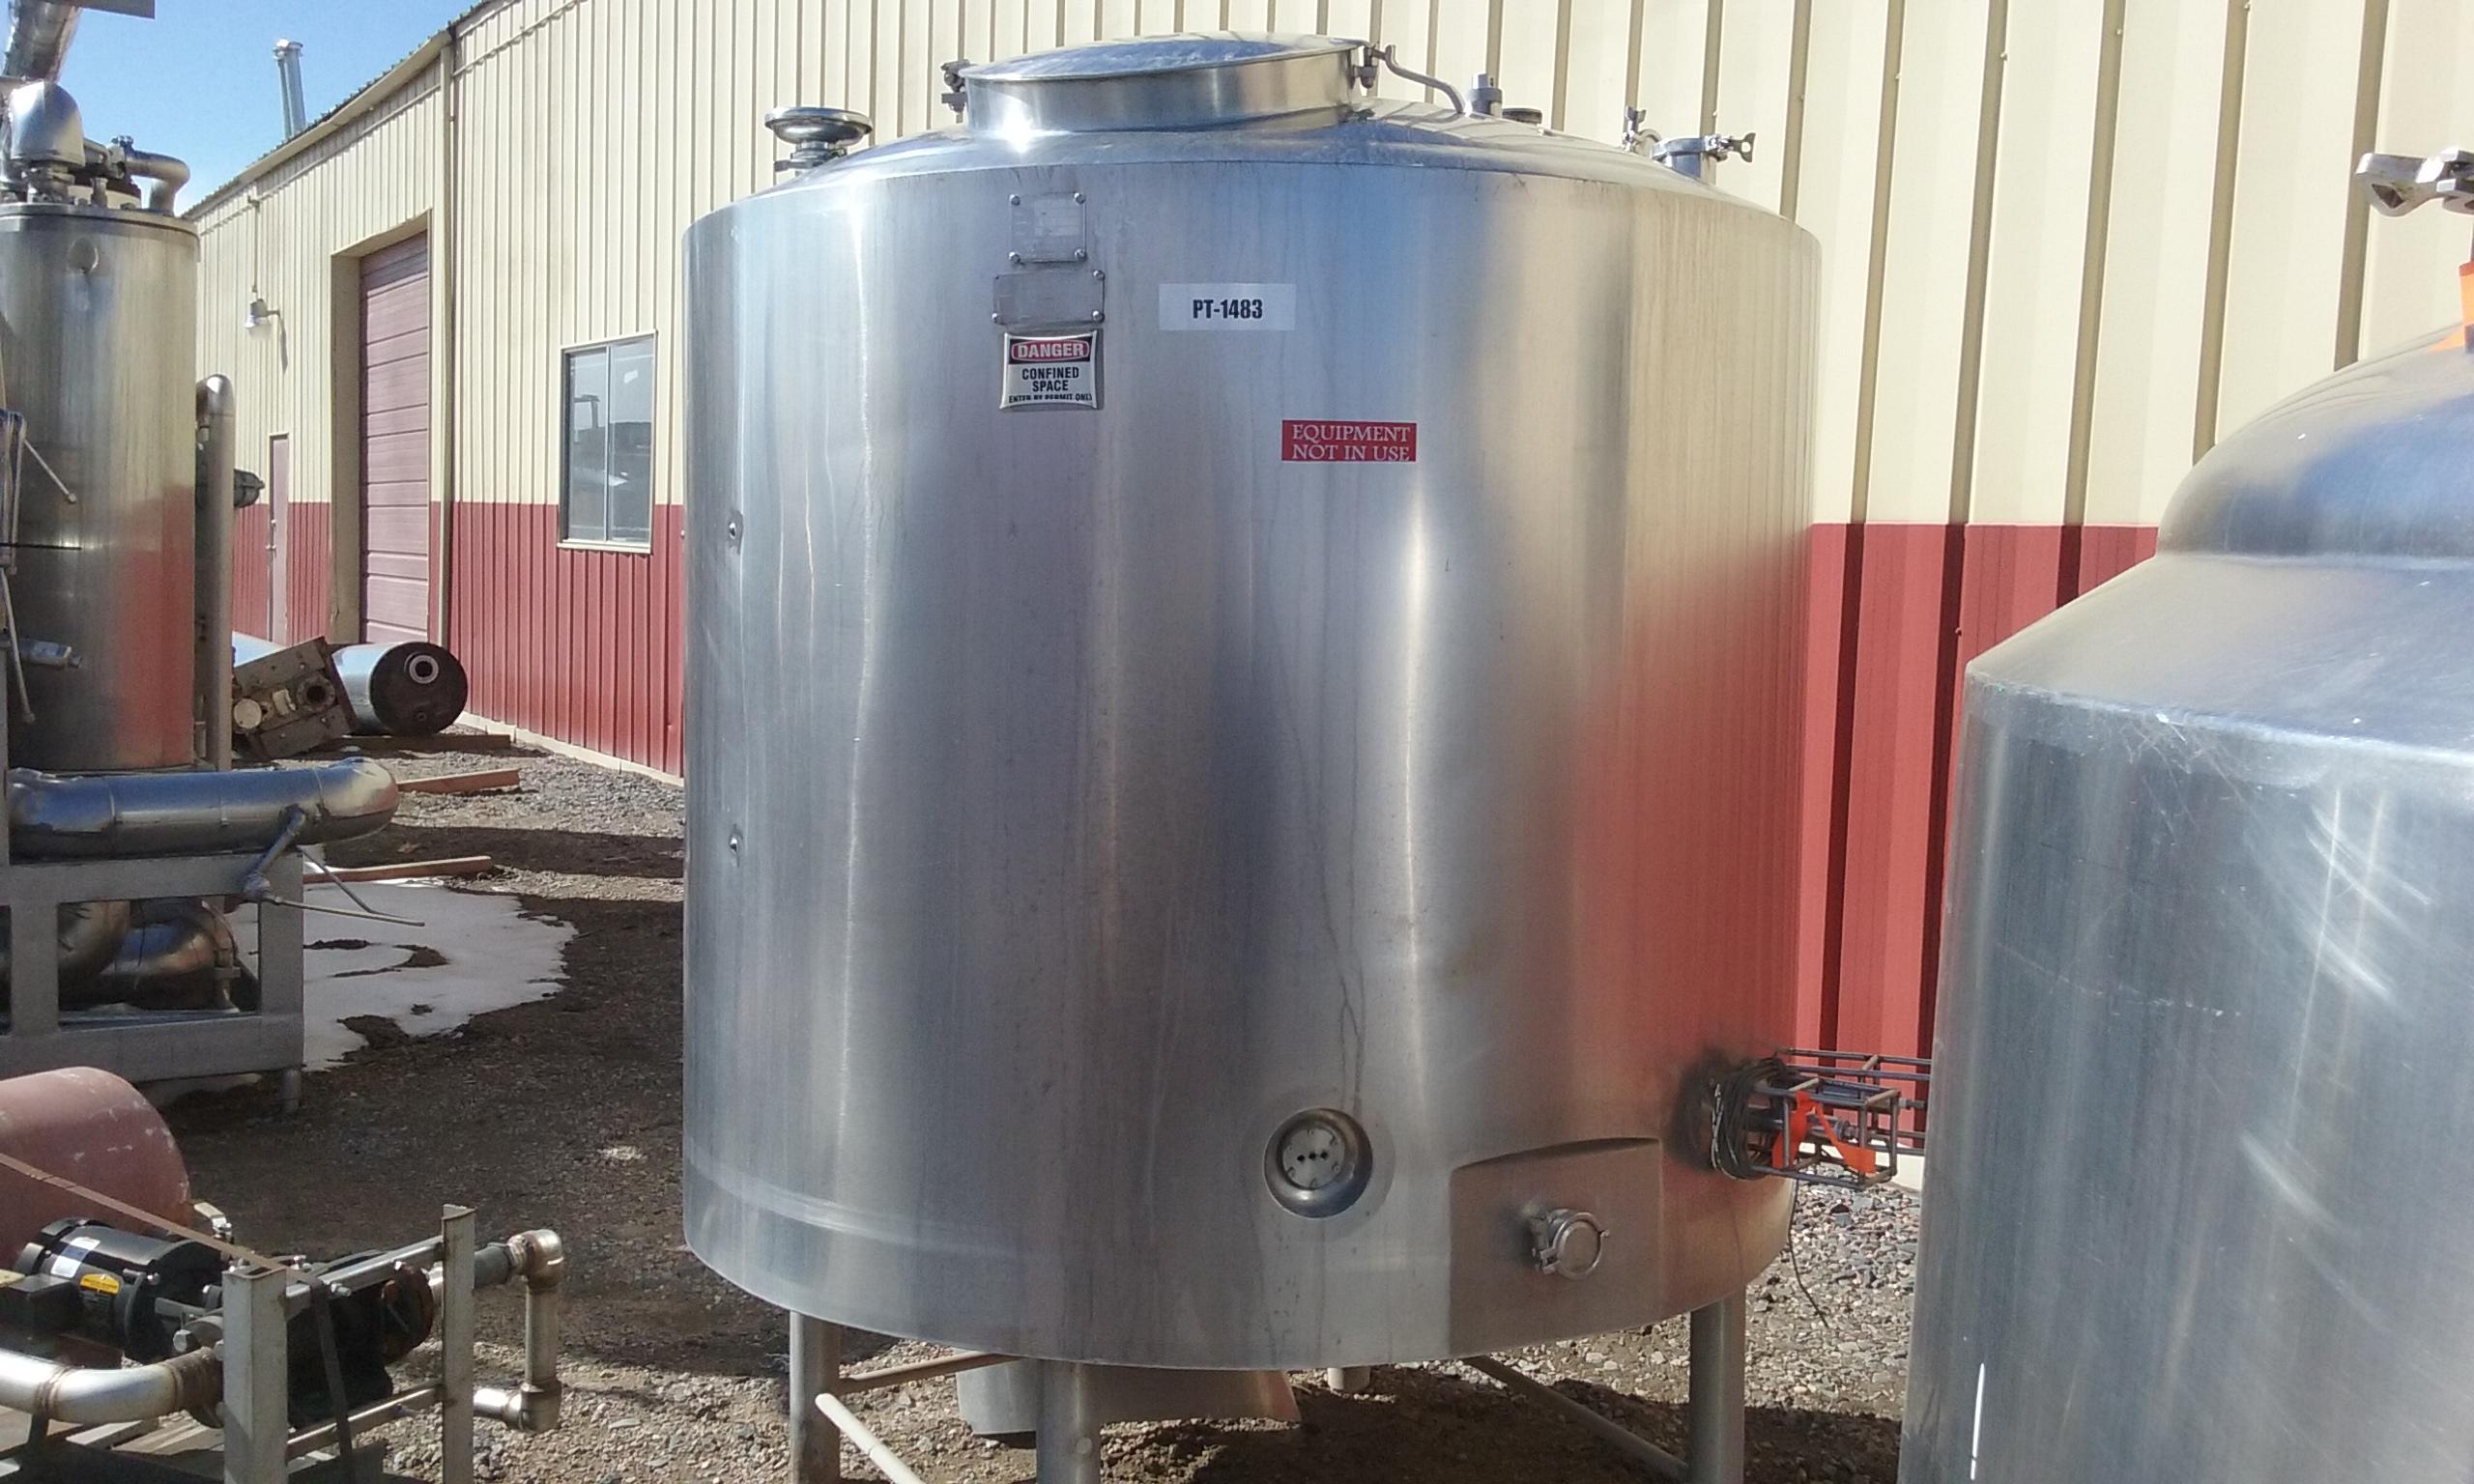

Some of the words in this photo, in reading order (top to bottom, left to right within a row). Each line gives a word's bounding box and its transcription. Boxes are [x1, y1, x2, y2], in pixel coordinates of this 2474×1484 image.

[1193, 299, 1263, 319] PT-1483
[1018, 343, 1083, 358] DANGER
[1021, 366, 1079, 380] CONFINED
[1032, 380, 1069, 392] SPACE
[1293, 424, 1410, 443] EQUIPMENT
[1292, 444, 1338, 460] NOT
[1344, 445, 1366, 460] IN
[1372, 445, 1410, 461] USE
